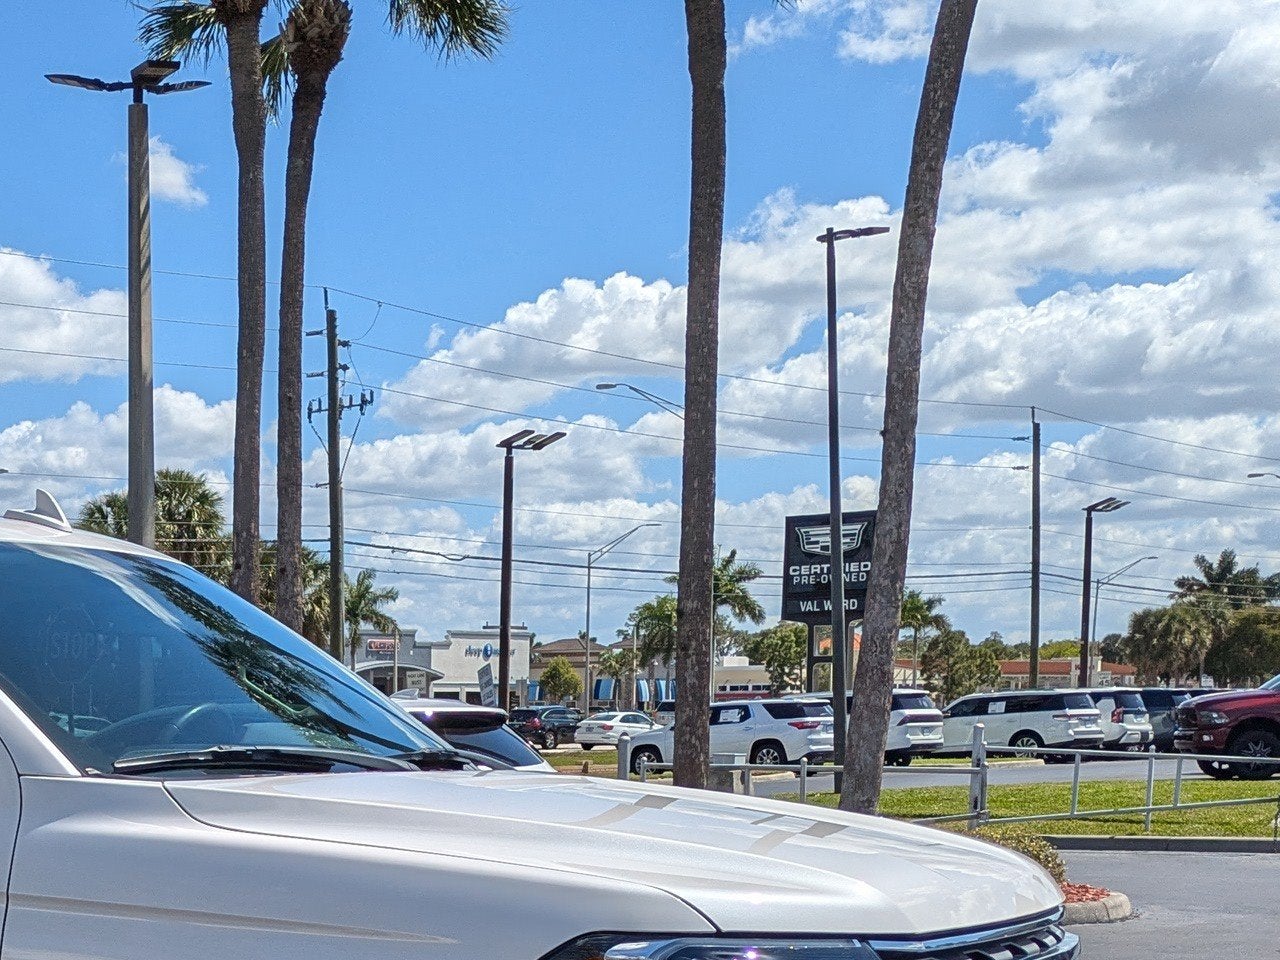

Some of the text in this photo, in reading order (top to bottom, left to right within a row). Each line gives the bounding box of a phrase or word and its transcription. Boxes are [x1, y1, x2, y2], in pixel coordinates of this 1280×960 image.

[789, 561, 872, 576] CERTIED
[793, 572, 867, 585] PRE-ONED
[800, 598, 858, 612] VAL WRD
